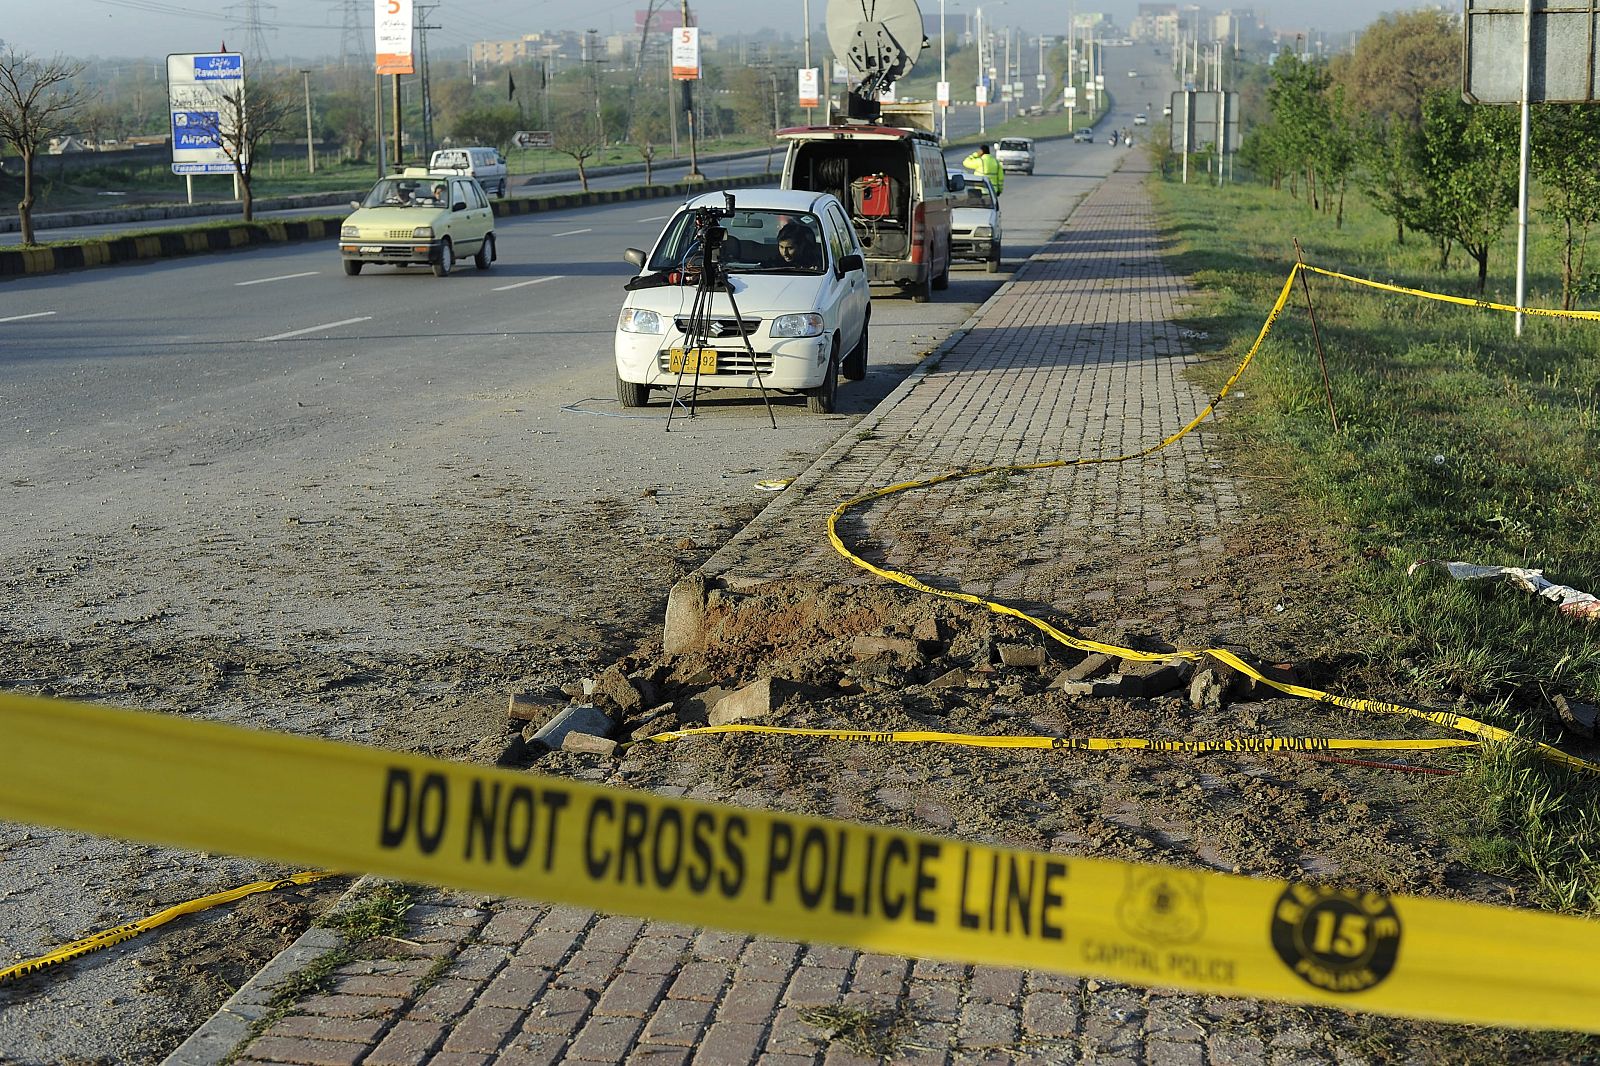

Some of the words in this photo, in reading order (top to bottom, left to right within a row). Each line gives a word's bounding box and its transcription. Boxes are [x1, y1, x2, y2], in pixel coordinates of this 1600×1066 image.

[682, 30, 690, 43] 5
[380, 767, 449, 855] DO
[464, 779, 570, 872] NOT
[585, 796, 749, 899] CROSS
[765, 820, 940, 924] POLICE
[959, 847, 1068, 940] LINE
[1313, 909, 1368, 957] 15
[1081, 940, 1159, 975] CAPITAL
[1170, 952, 1238, 985] POLICE
